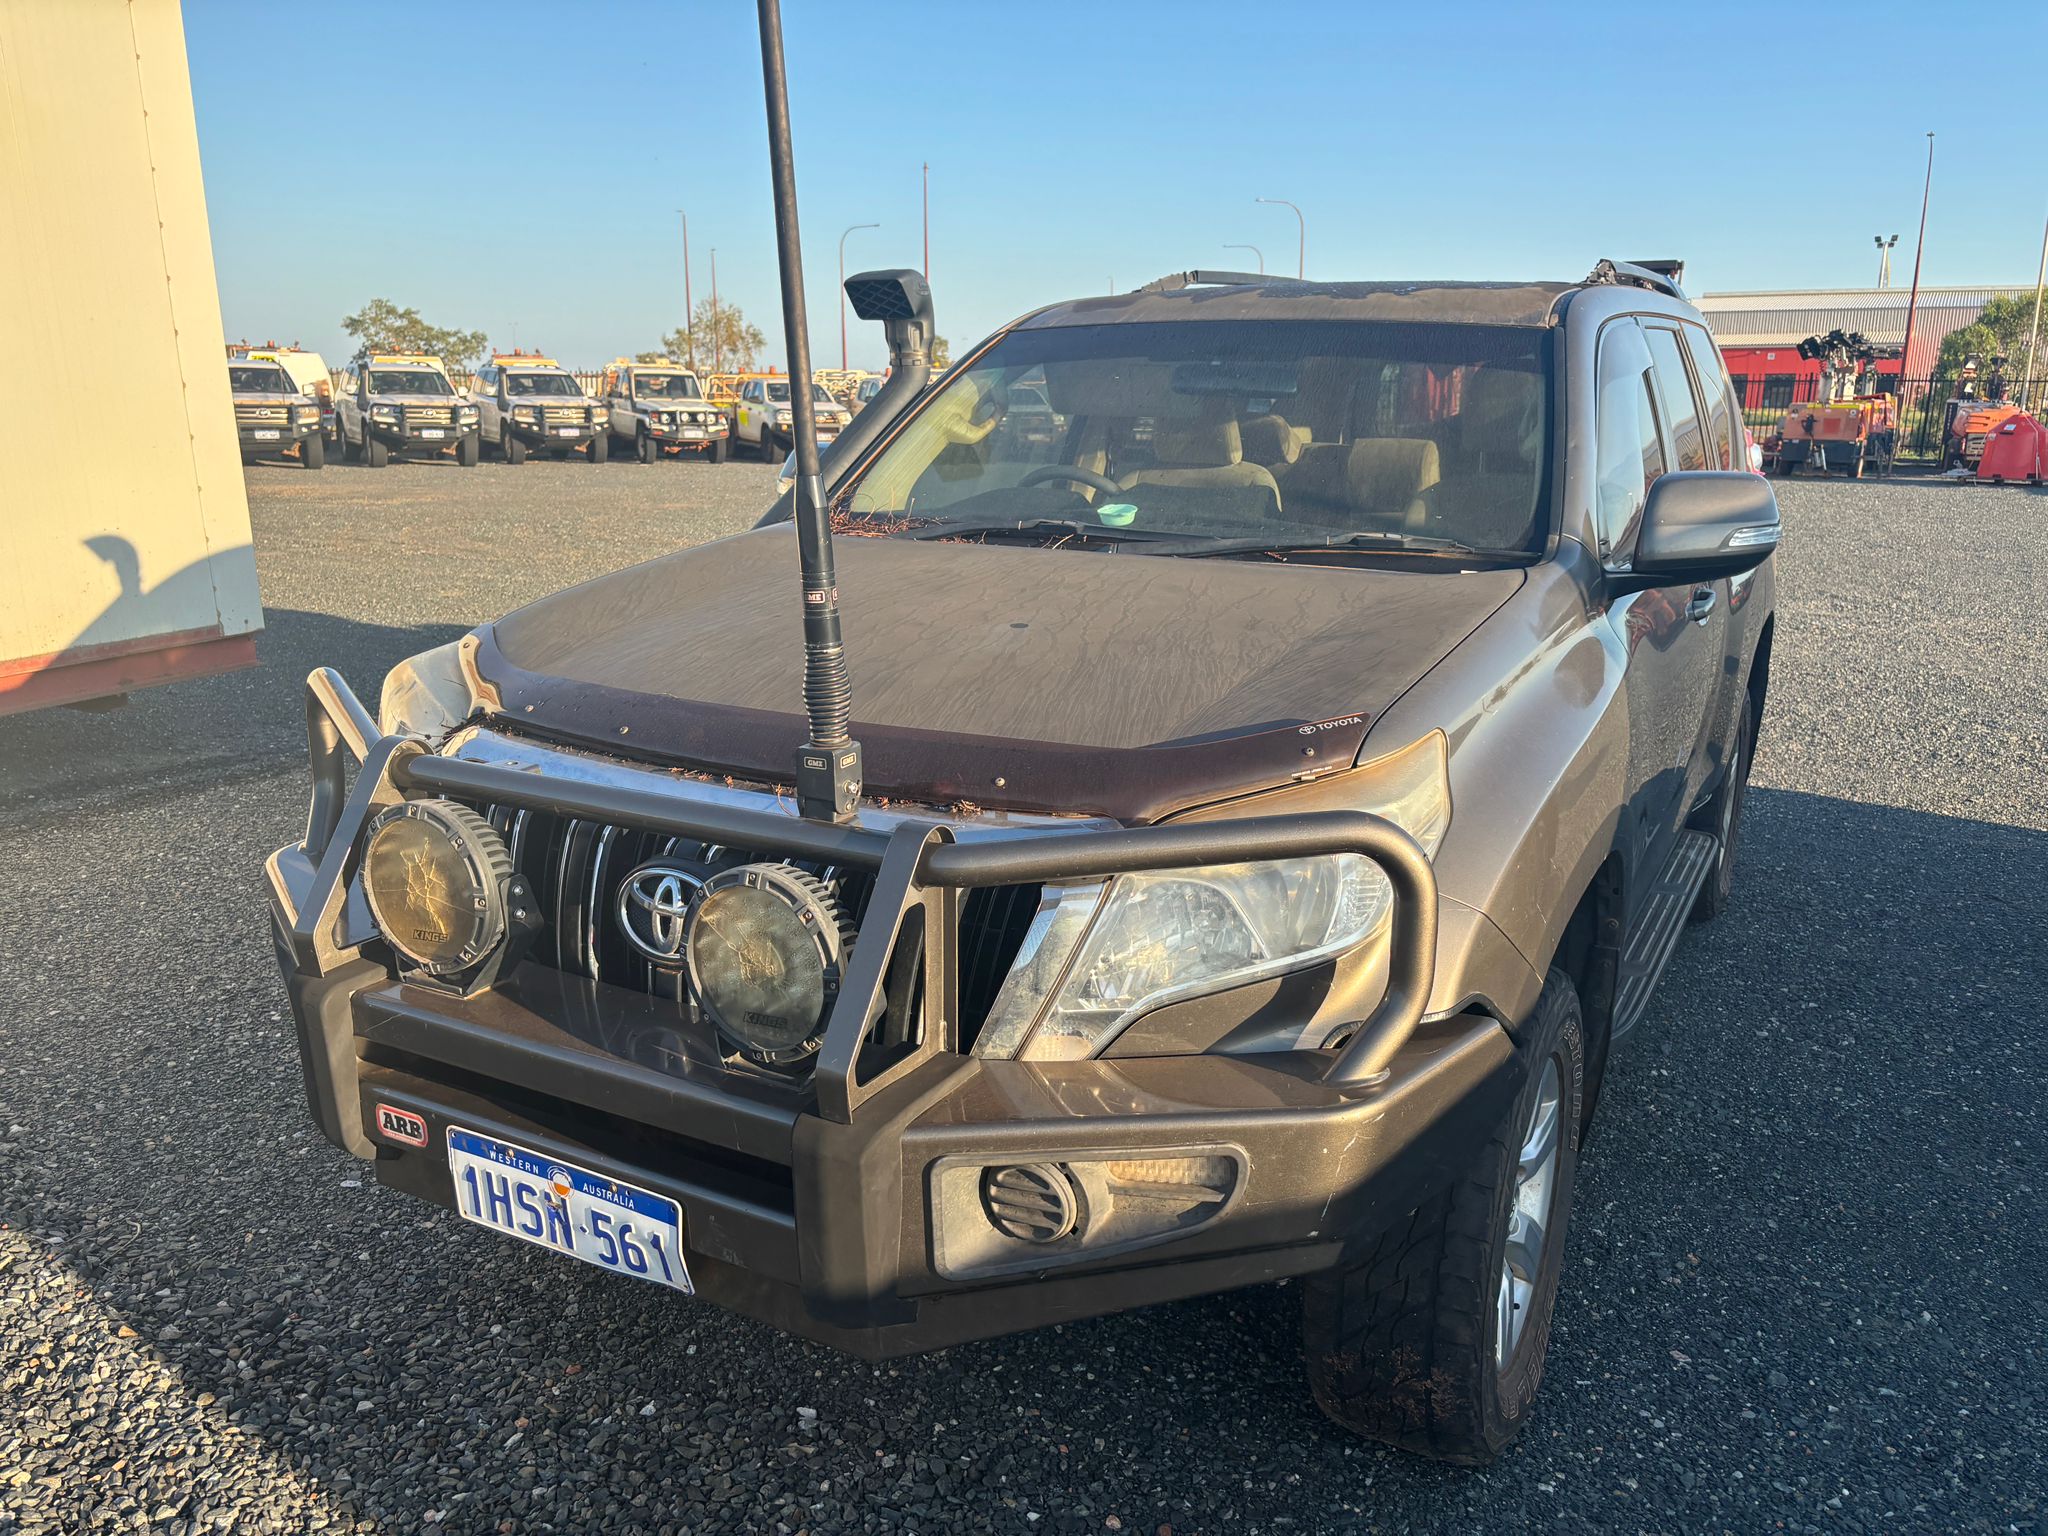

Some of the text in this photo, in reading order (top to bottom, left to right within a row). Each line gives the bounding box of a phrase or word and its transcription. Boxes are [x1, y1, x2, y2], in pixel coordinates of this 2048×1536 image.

[1316, 717, 1362, 731] TOYOTA
[412, 929, 449, 943] KINGS
[383, 1111, 423, 1140] ARB
[489, 1150, 635, 1210] WESTERN AUSTRALIA
